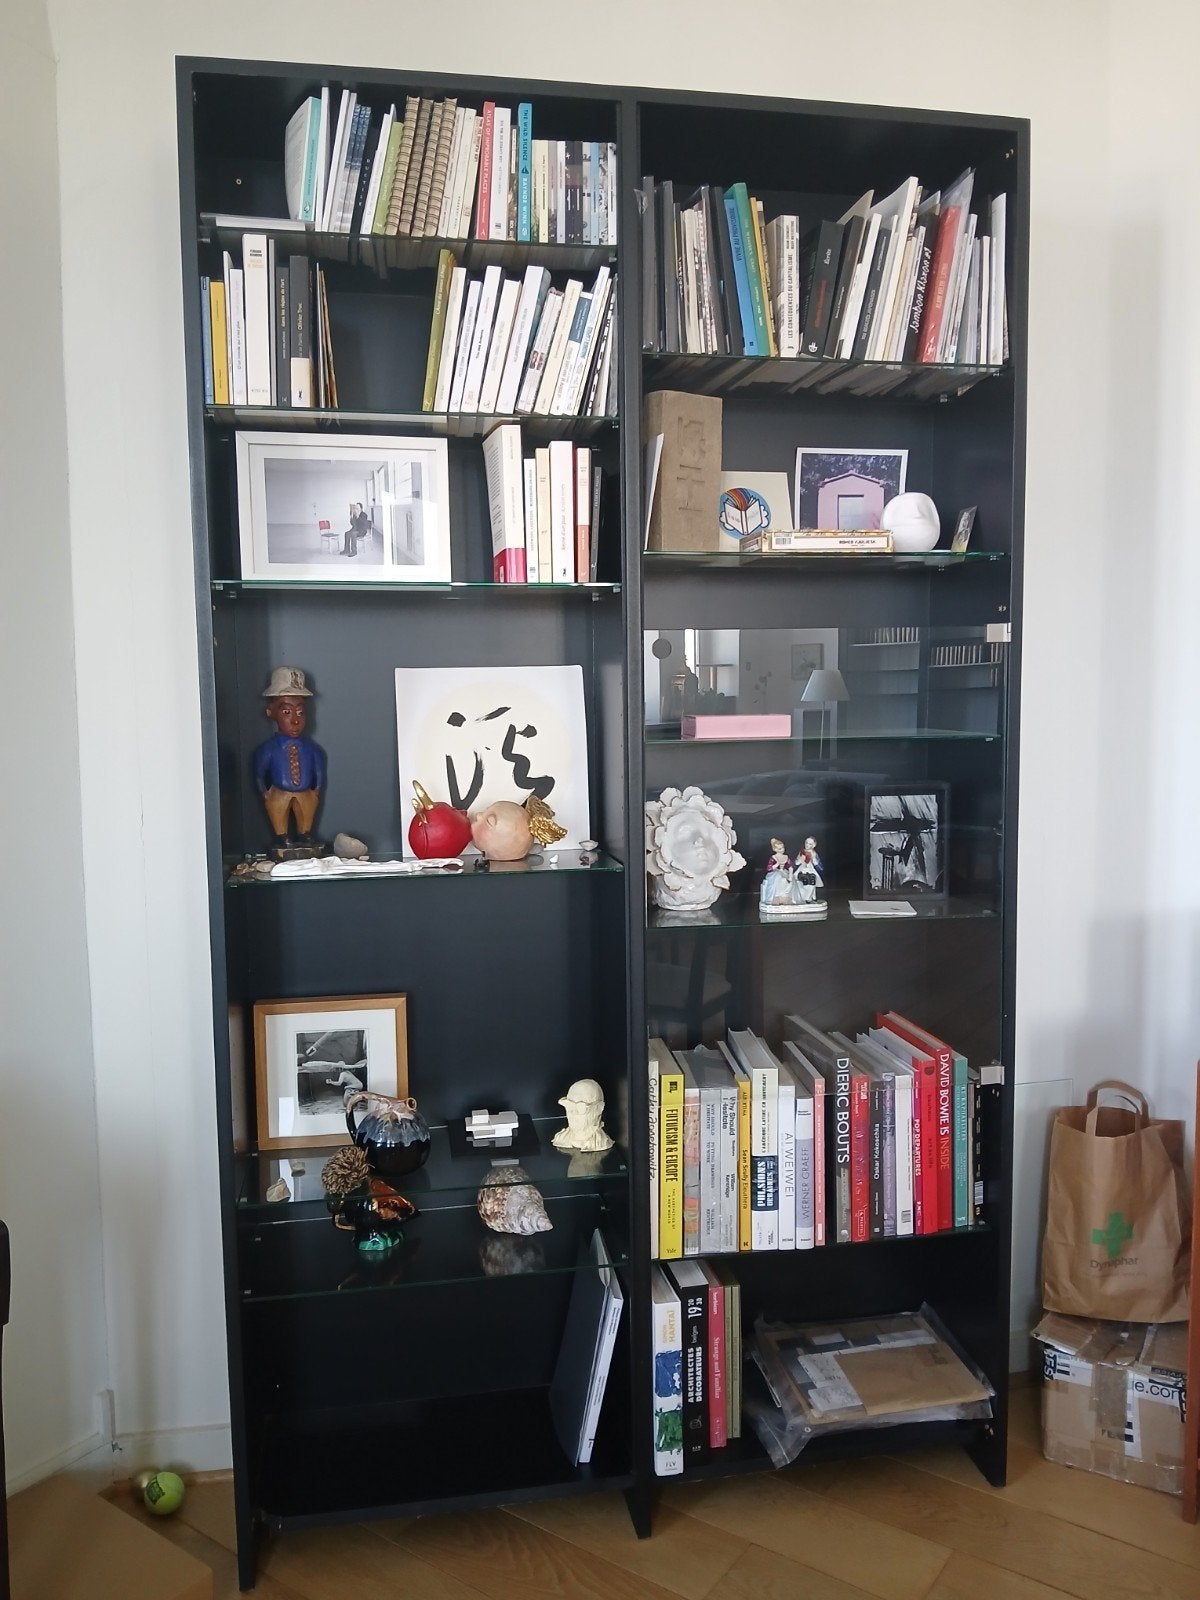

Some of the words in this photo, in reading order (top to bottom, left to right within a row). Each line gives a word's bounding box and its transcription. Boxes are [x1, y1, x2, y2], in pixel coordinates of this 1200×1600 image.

[910, 294, 923, 333] Jambon
[917, 260, 930, 293] Klaxon
[837, 1058, 849, 1107] DIERIC
[940, 1054, 950, 1087] DAVID
[940, 1089, 949, 1125] BOWIE
[666, 1109, 678, 1144] FUTURISM
[784, 1133, 793, 1145] AI
[837, 1112, 849, 1163] BOUTS
[940, 1126, 949, 1135] IS
[666, 1154, 678, 1182] EUROPE
[801, 1148, 810, 1180] GRAEFF
[940, 1137, 949, 1170] INSIDE
[757, 1161, 766, 1206] PULSIONS
[801, 1182, 810, 1219] WERNER
[688, 1307, 702, 1318] 19
